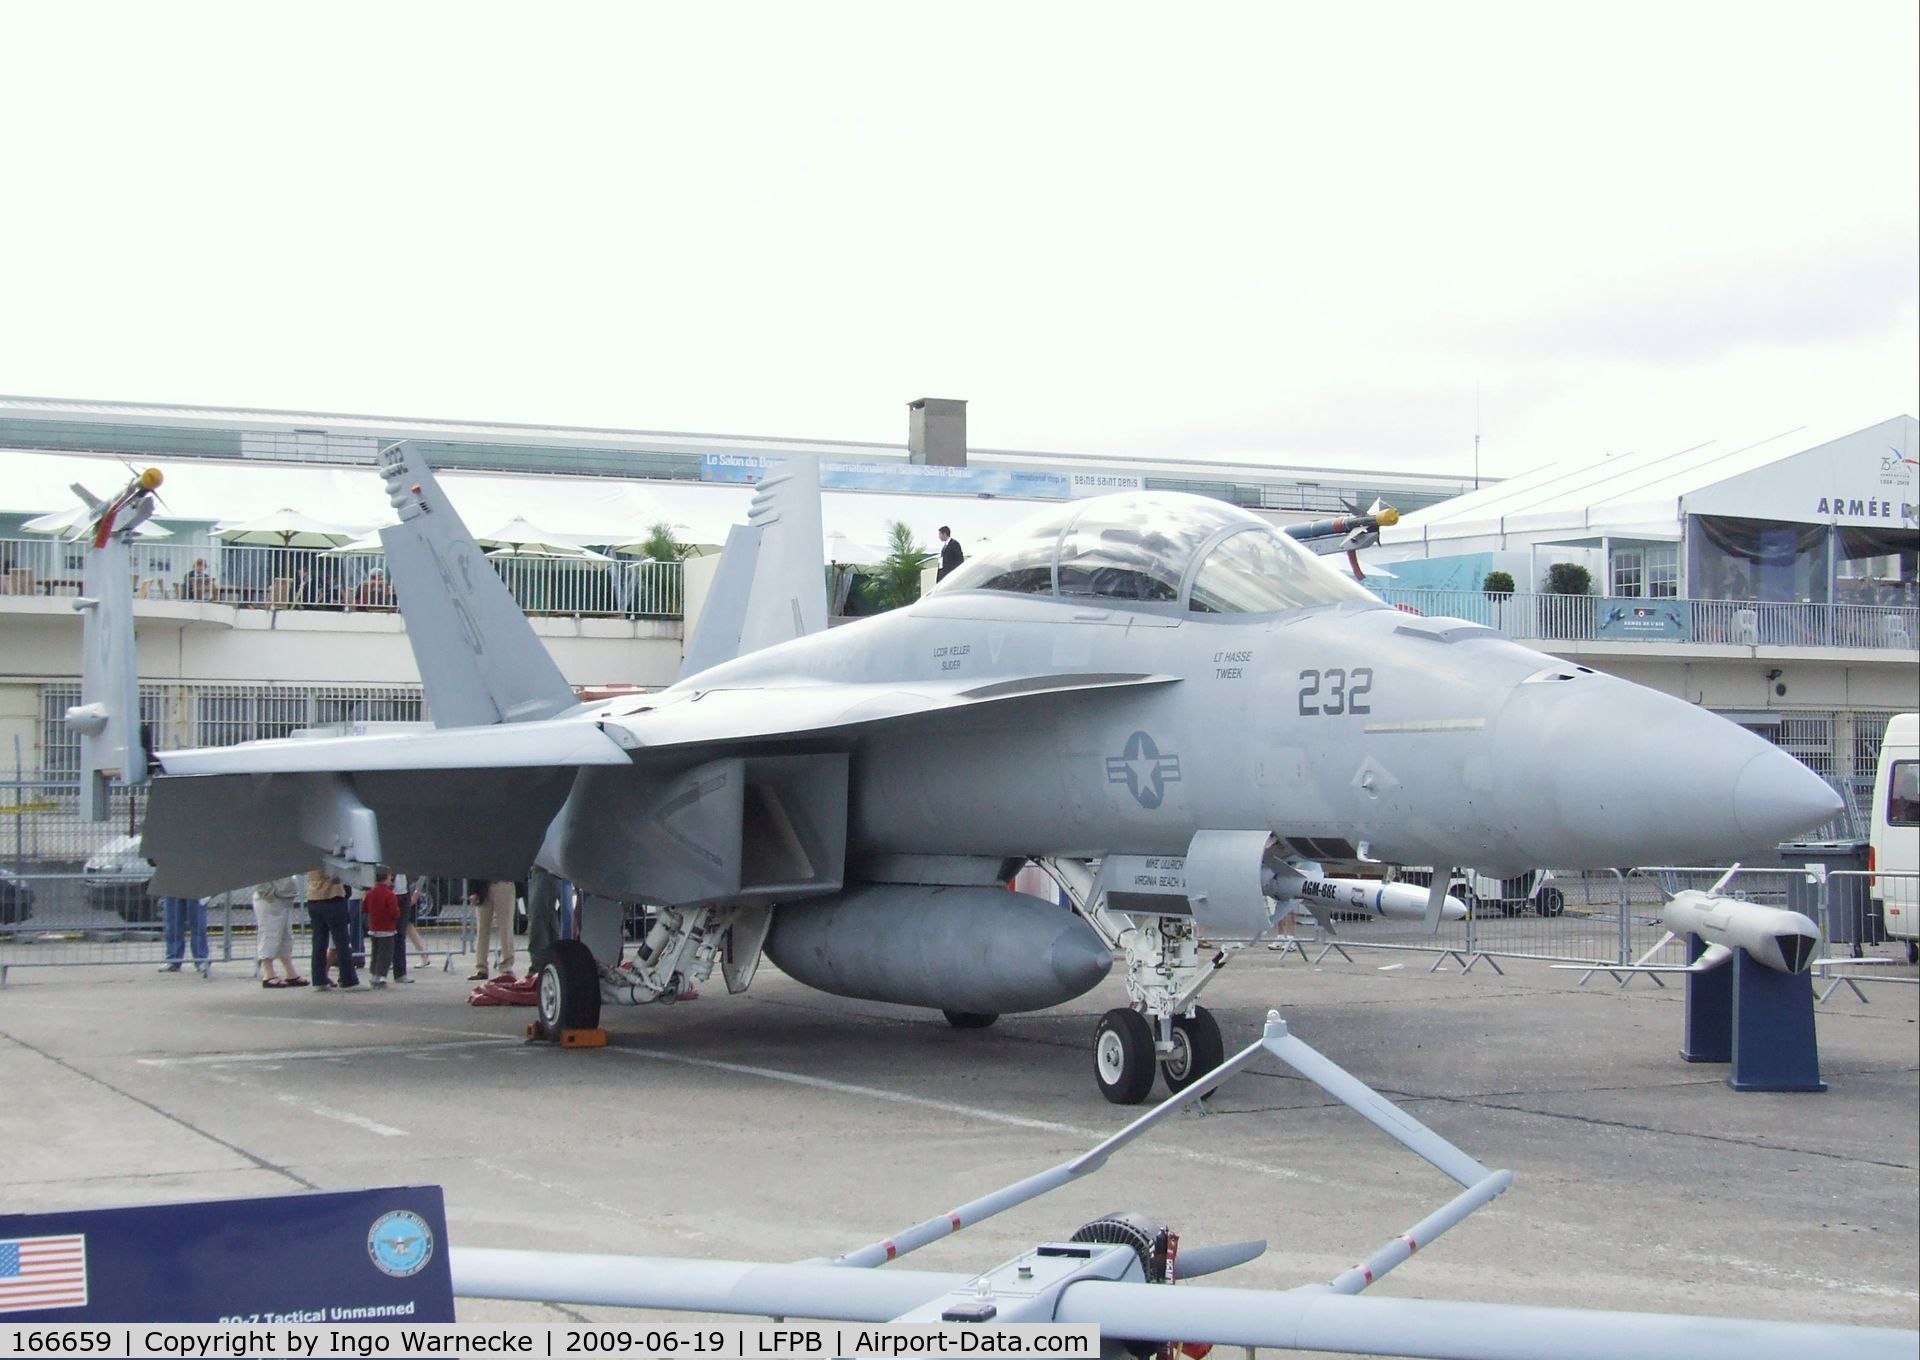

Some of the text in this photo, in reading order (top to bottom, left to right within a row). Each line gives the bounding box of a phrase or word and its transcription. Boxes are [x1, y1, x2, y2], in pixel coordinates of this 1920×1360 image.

[706, 453, 718, 465] Le
[719, 454, 744, 467] Salon
[745, 456, 758, 468] du
[1817, 496, 1890, 518] ARMÉE
[949, 645, 970, 656] KELLER
[1213, 651, 1253, 663] LT HASSE
[941, 660, 961, 671] SLIDER
[1215, 668, 1243, 679] TWEEK
[1298, 667, 1373, 716] 232
[1301, 880, 1337, 900] AGM-88E
[263, 1308, 327, 1324] Tactical
[330, 1300, 416, 1321] Unmanned
